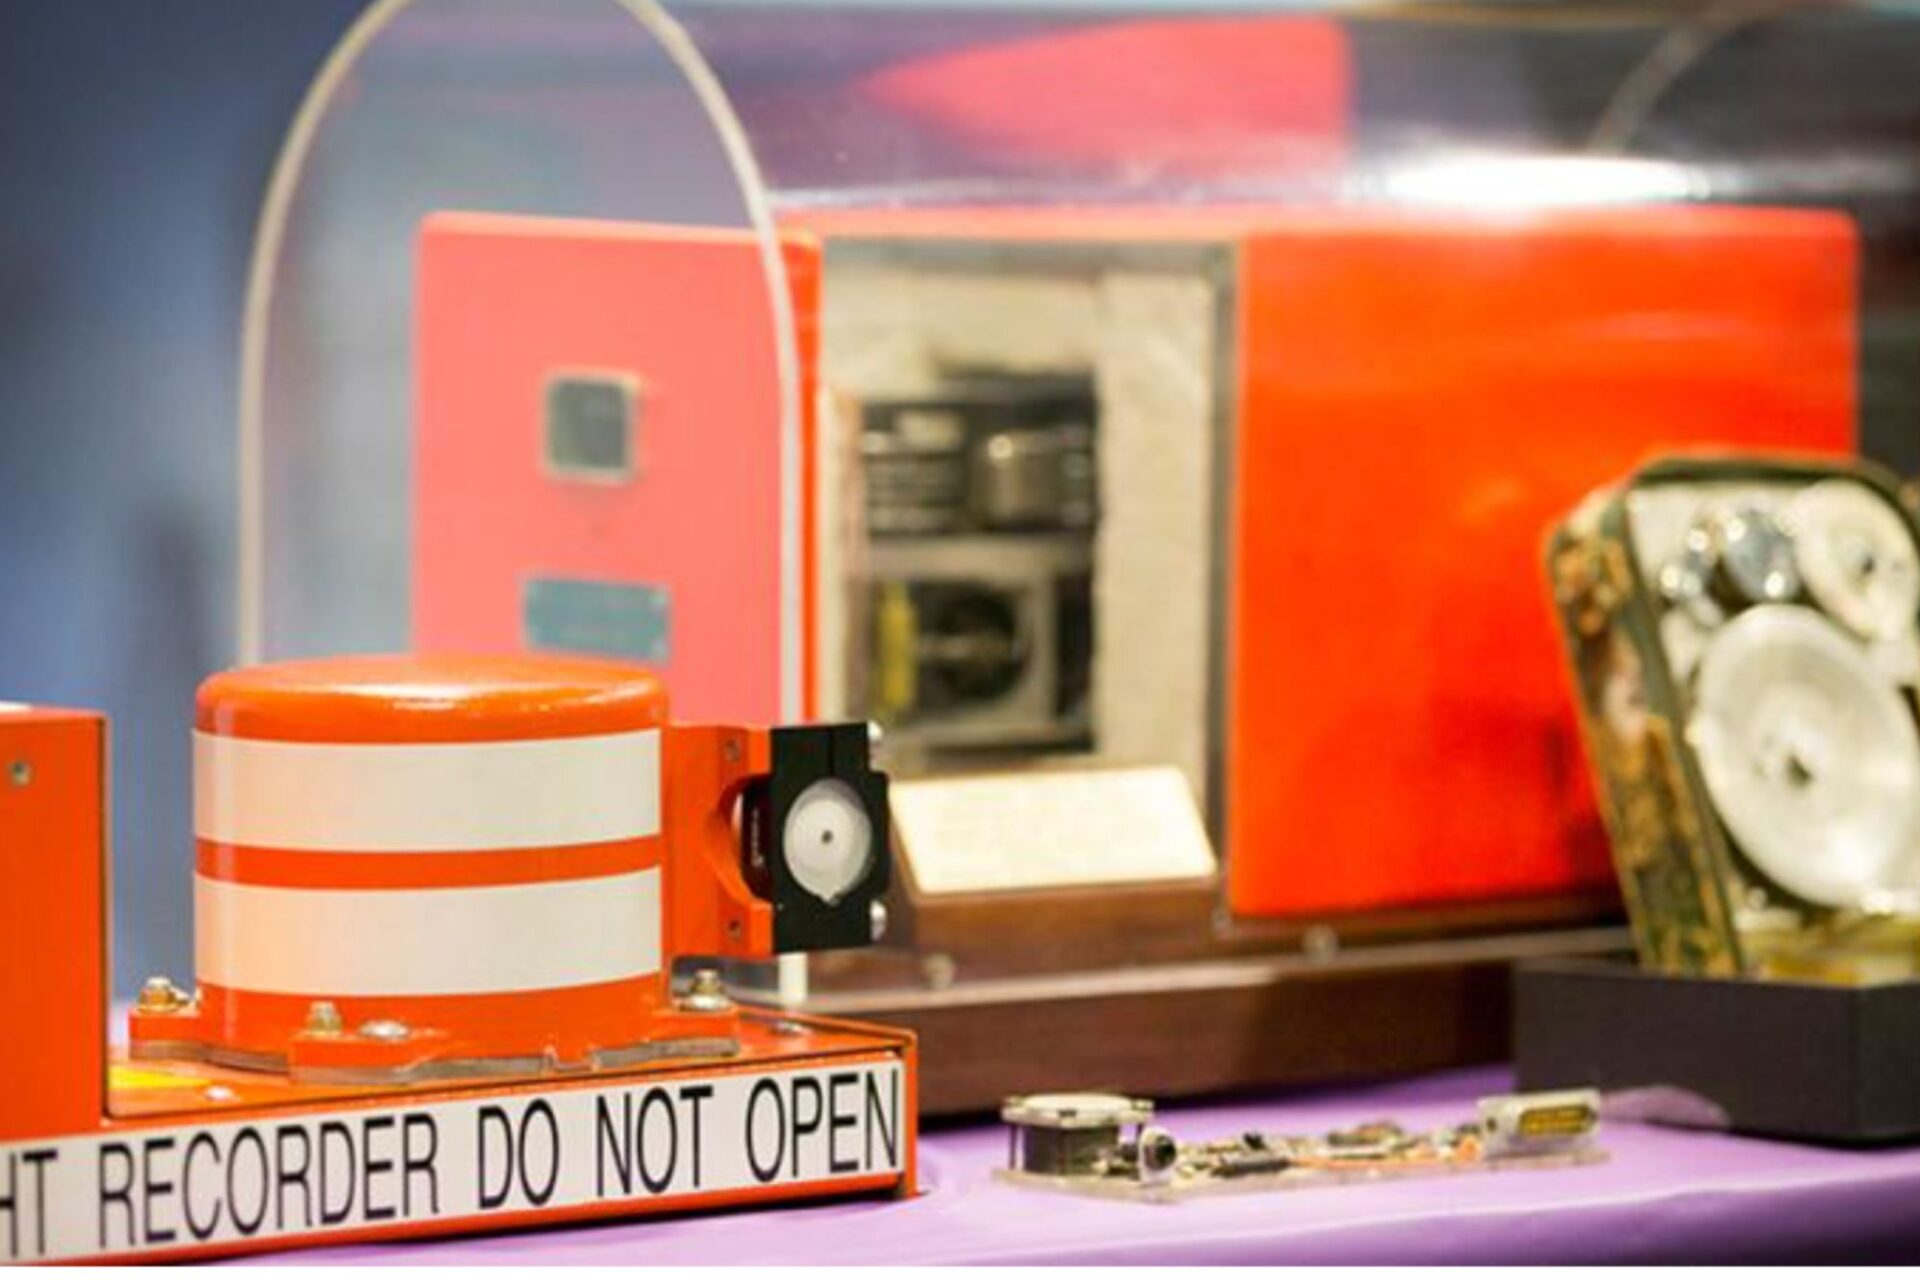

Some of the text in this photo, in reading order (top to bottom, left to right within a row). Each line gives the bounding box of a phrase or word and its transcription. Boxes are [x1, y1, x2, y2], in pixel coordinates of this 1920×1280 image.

[100, 1113, 439, 1249] RECORDER
[478, 1099, 561, 1209] DO
[597, 1086, 714, 1197] NOT
[745, 1068, 898, 1183] OPEN
